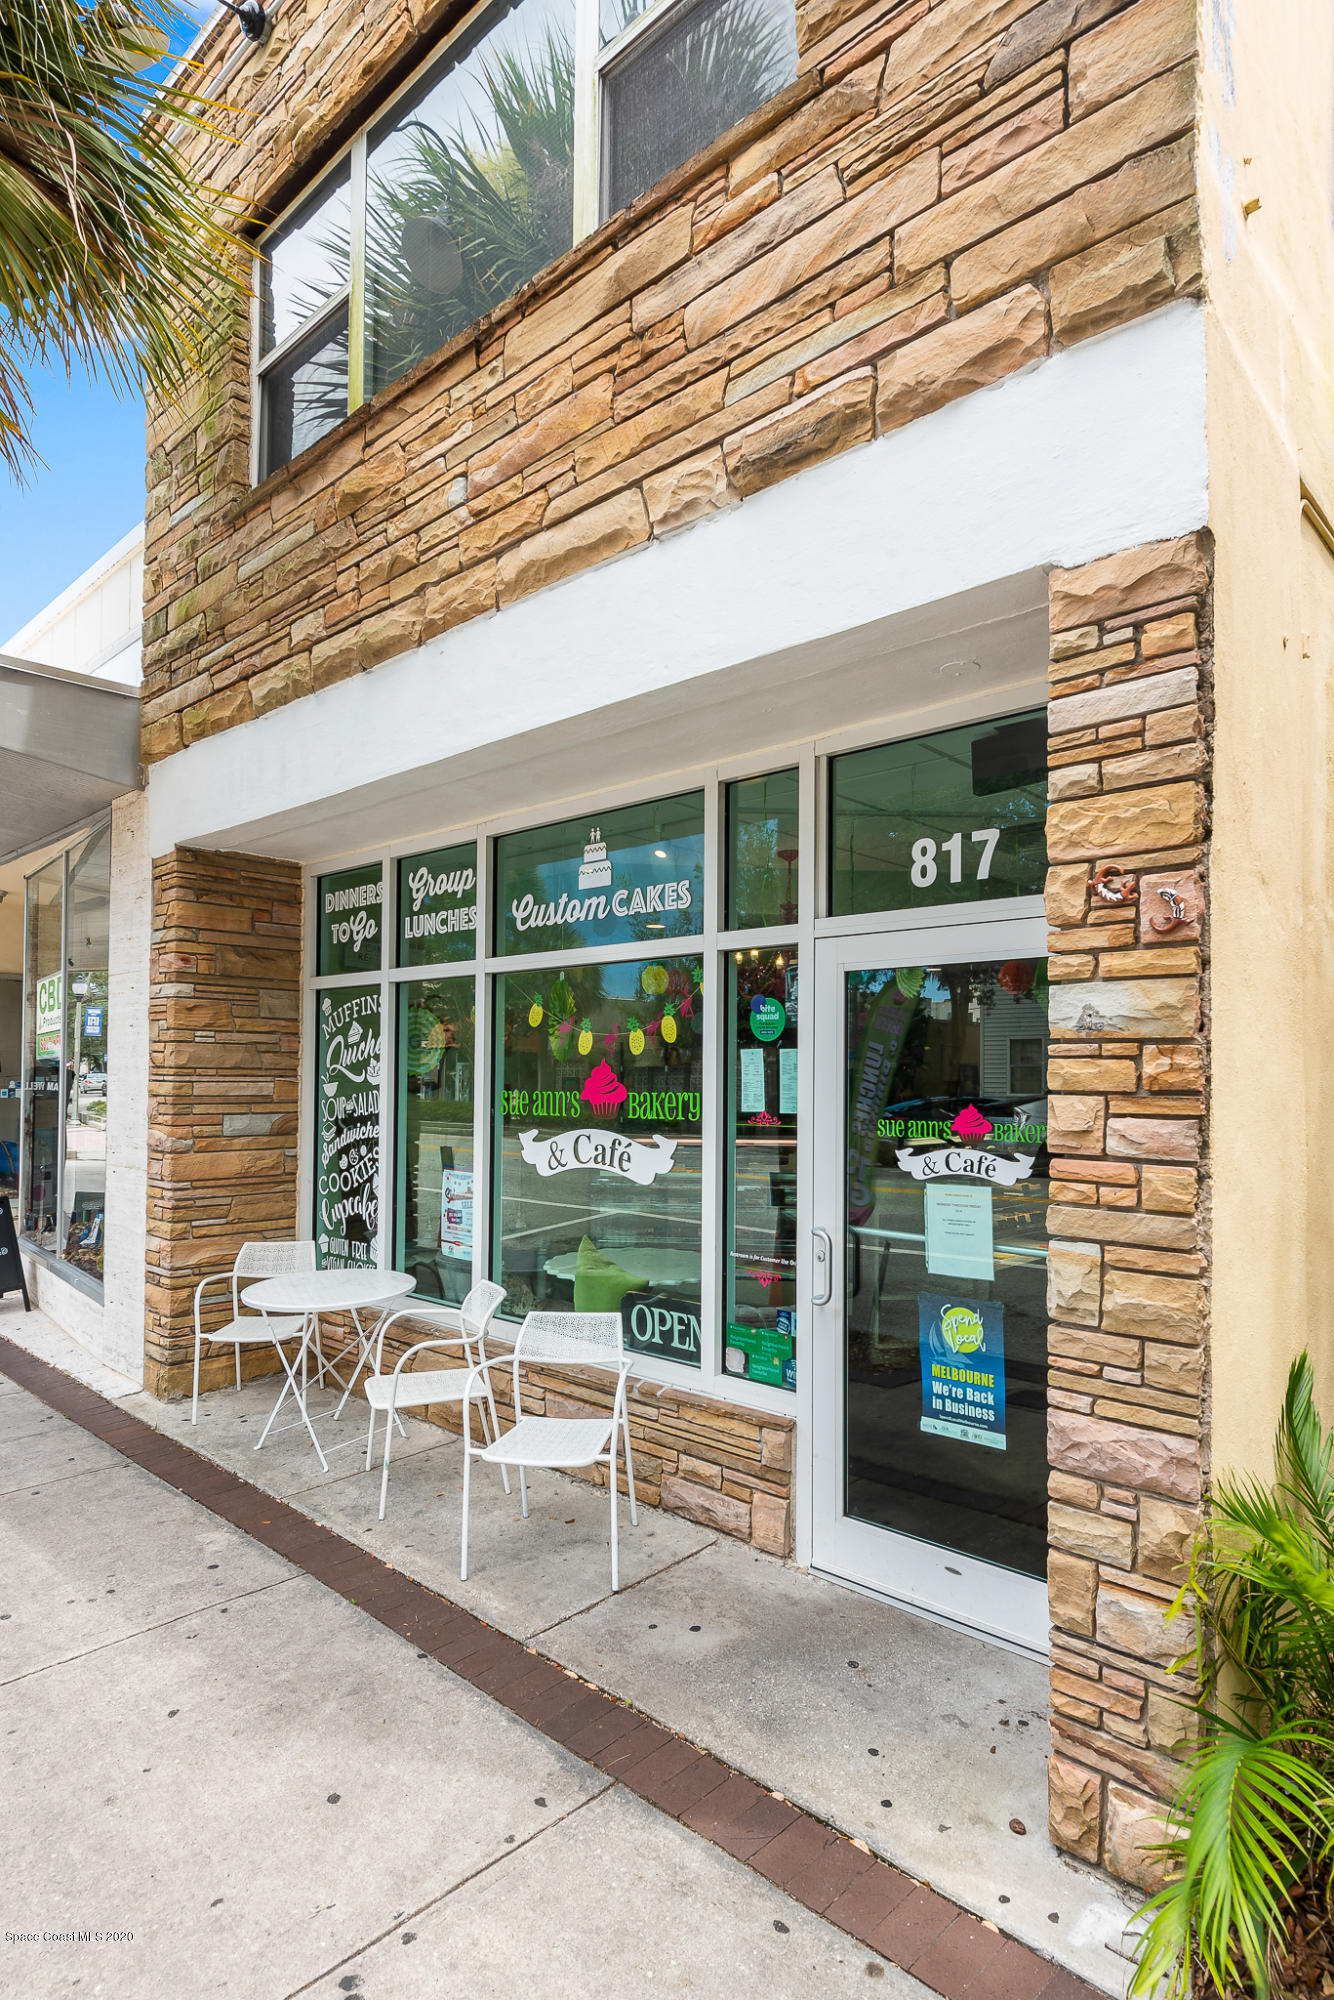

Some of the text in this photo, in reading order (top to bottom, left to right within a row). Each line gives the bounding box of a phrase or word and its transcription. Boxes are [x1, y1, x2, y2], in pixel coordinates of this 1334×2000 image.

[910, 828, 1000, 888] 817
[325, 882, 384, 913] DINNERS
[408, 867, 476, 911] Group
[512, 880, 692, 931] Custom CAKES
[350, 911, 378, 952] Go
[405, 906, 477, 939] LUNCHES
[321, 1096, 347, 1122] SOUP
[500, 1089, 700, 1121] sue ann's Bakery
[877, 1119, 1047, 1144] sue ann's Baker
[547, 1134, 632, 1172] & Café
[922, 1152, 997, 1178] & Café
[351, 1241, 368, 1260] FREE
[631, 1304, 702, 1352] OPEN
[941, 1304, 983, 1333] Spend
[948, 1327, 986, 1353] Local
[931, 1363, 995, 1388] MELBOURNE
[932, 1380, 995, 1405] We're Back
[945, 1398, 995, 1421] Business
